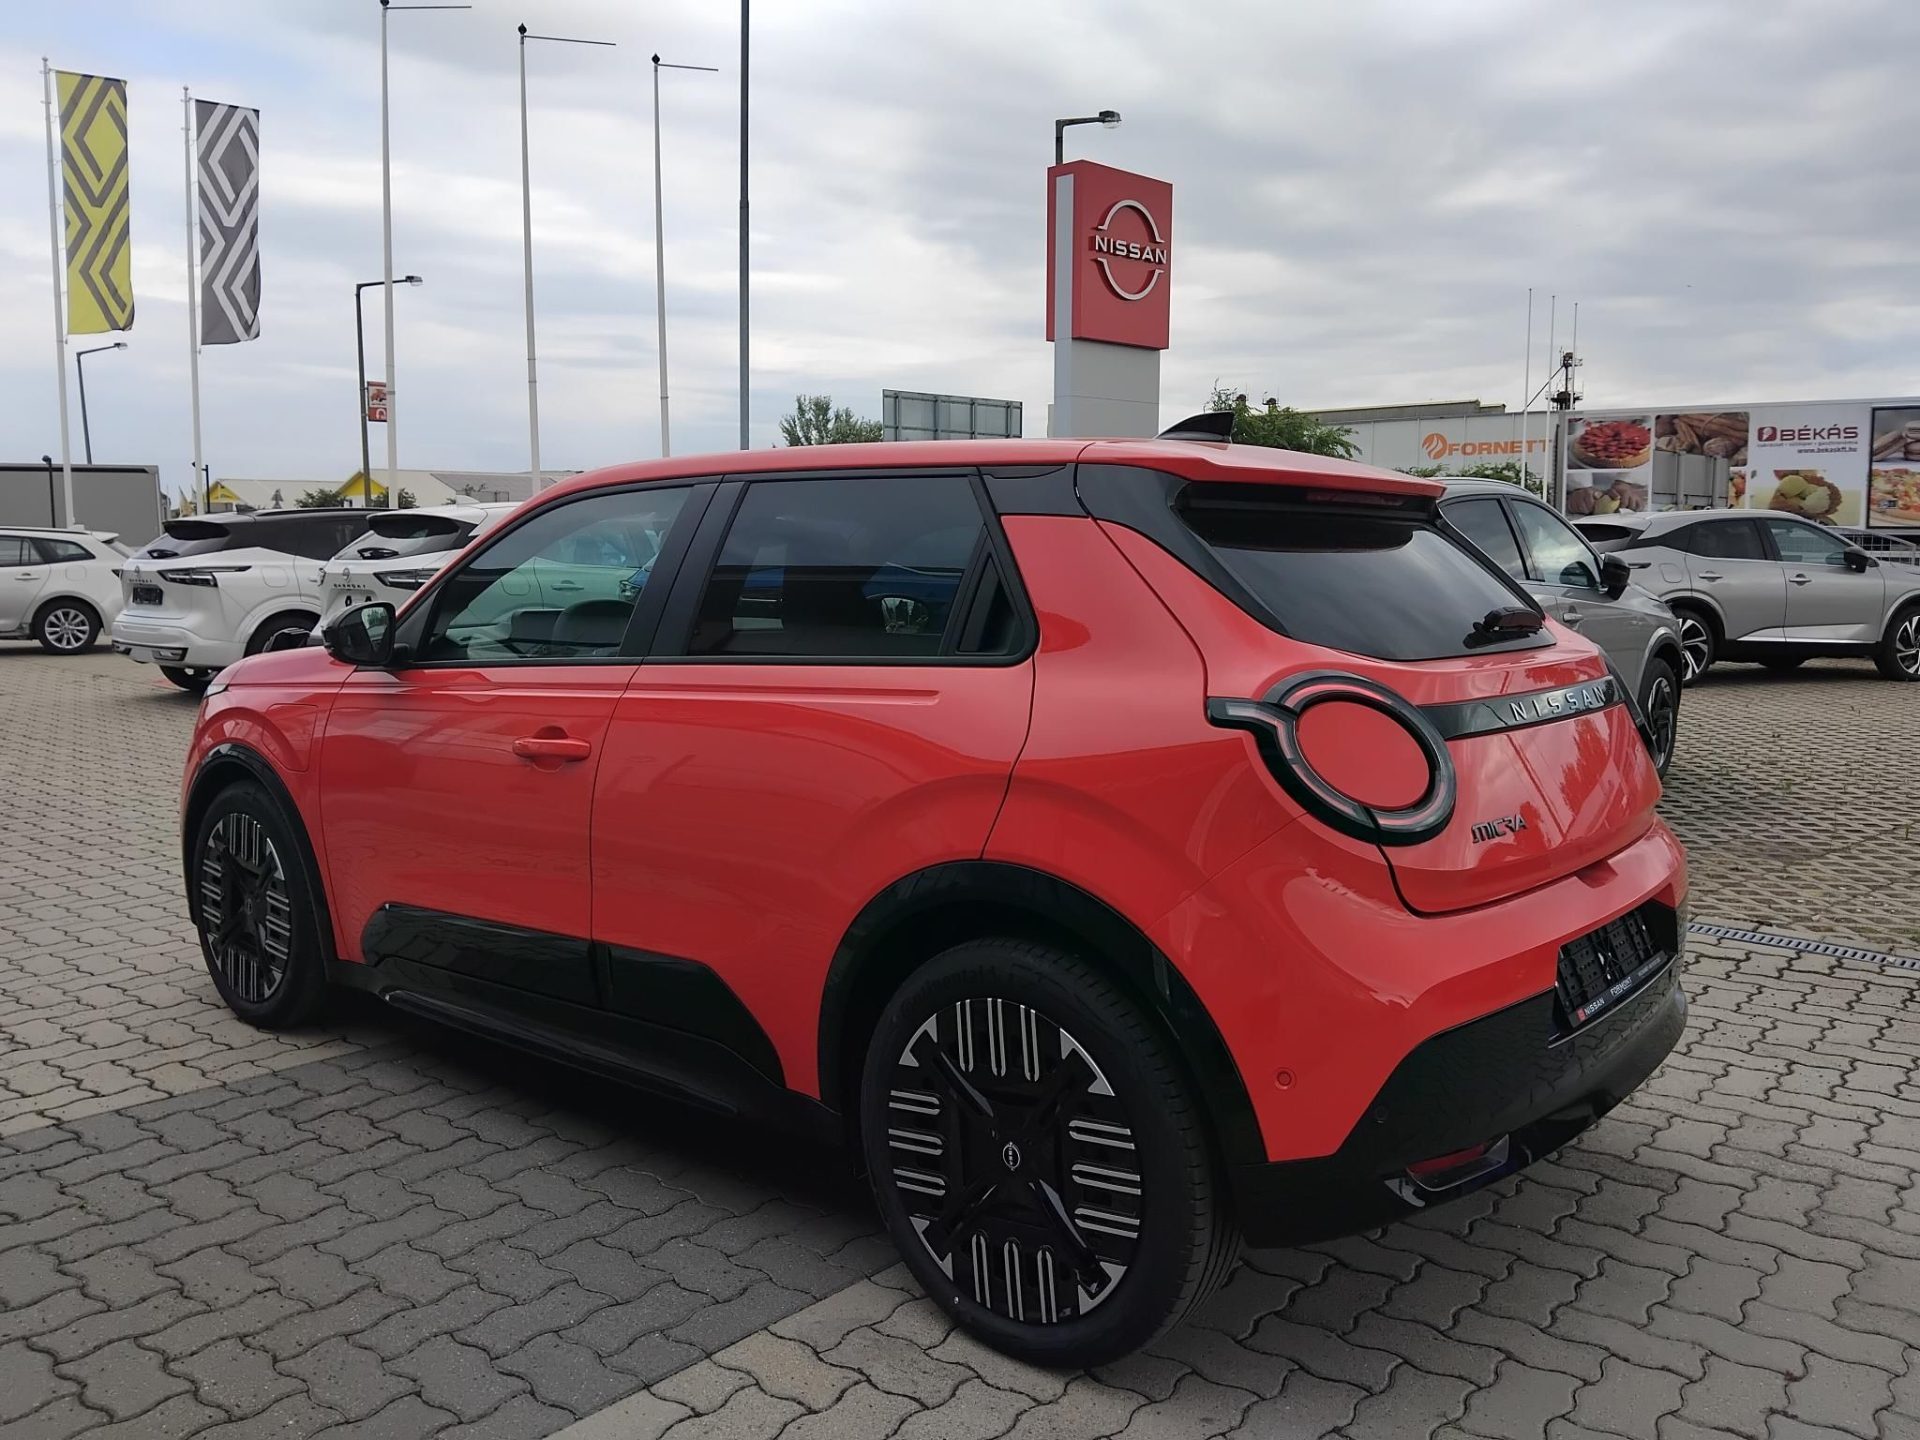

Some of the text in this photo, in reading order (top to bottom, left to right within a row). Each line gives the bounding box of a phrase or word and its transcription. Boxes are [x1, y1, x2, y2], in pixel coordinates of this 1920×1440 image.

[1095, 234, 1168, 265] NISSAN
[1780, 423, 1859, 441] BÉKÁS
[1509, 686, 1606, 722] NISSAN
[1471, 814, 1528, 844] MICRA
[1584, 997, 1605, 1016] NISSAN
